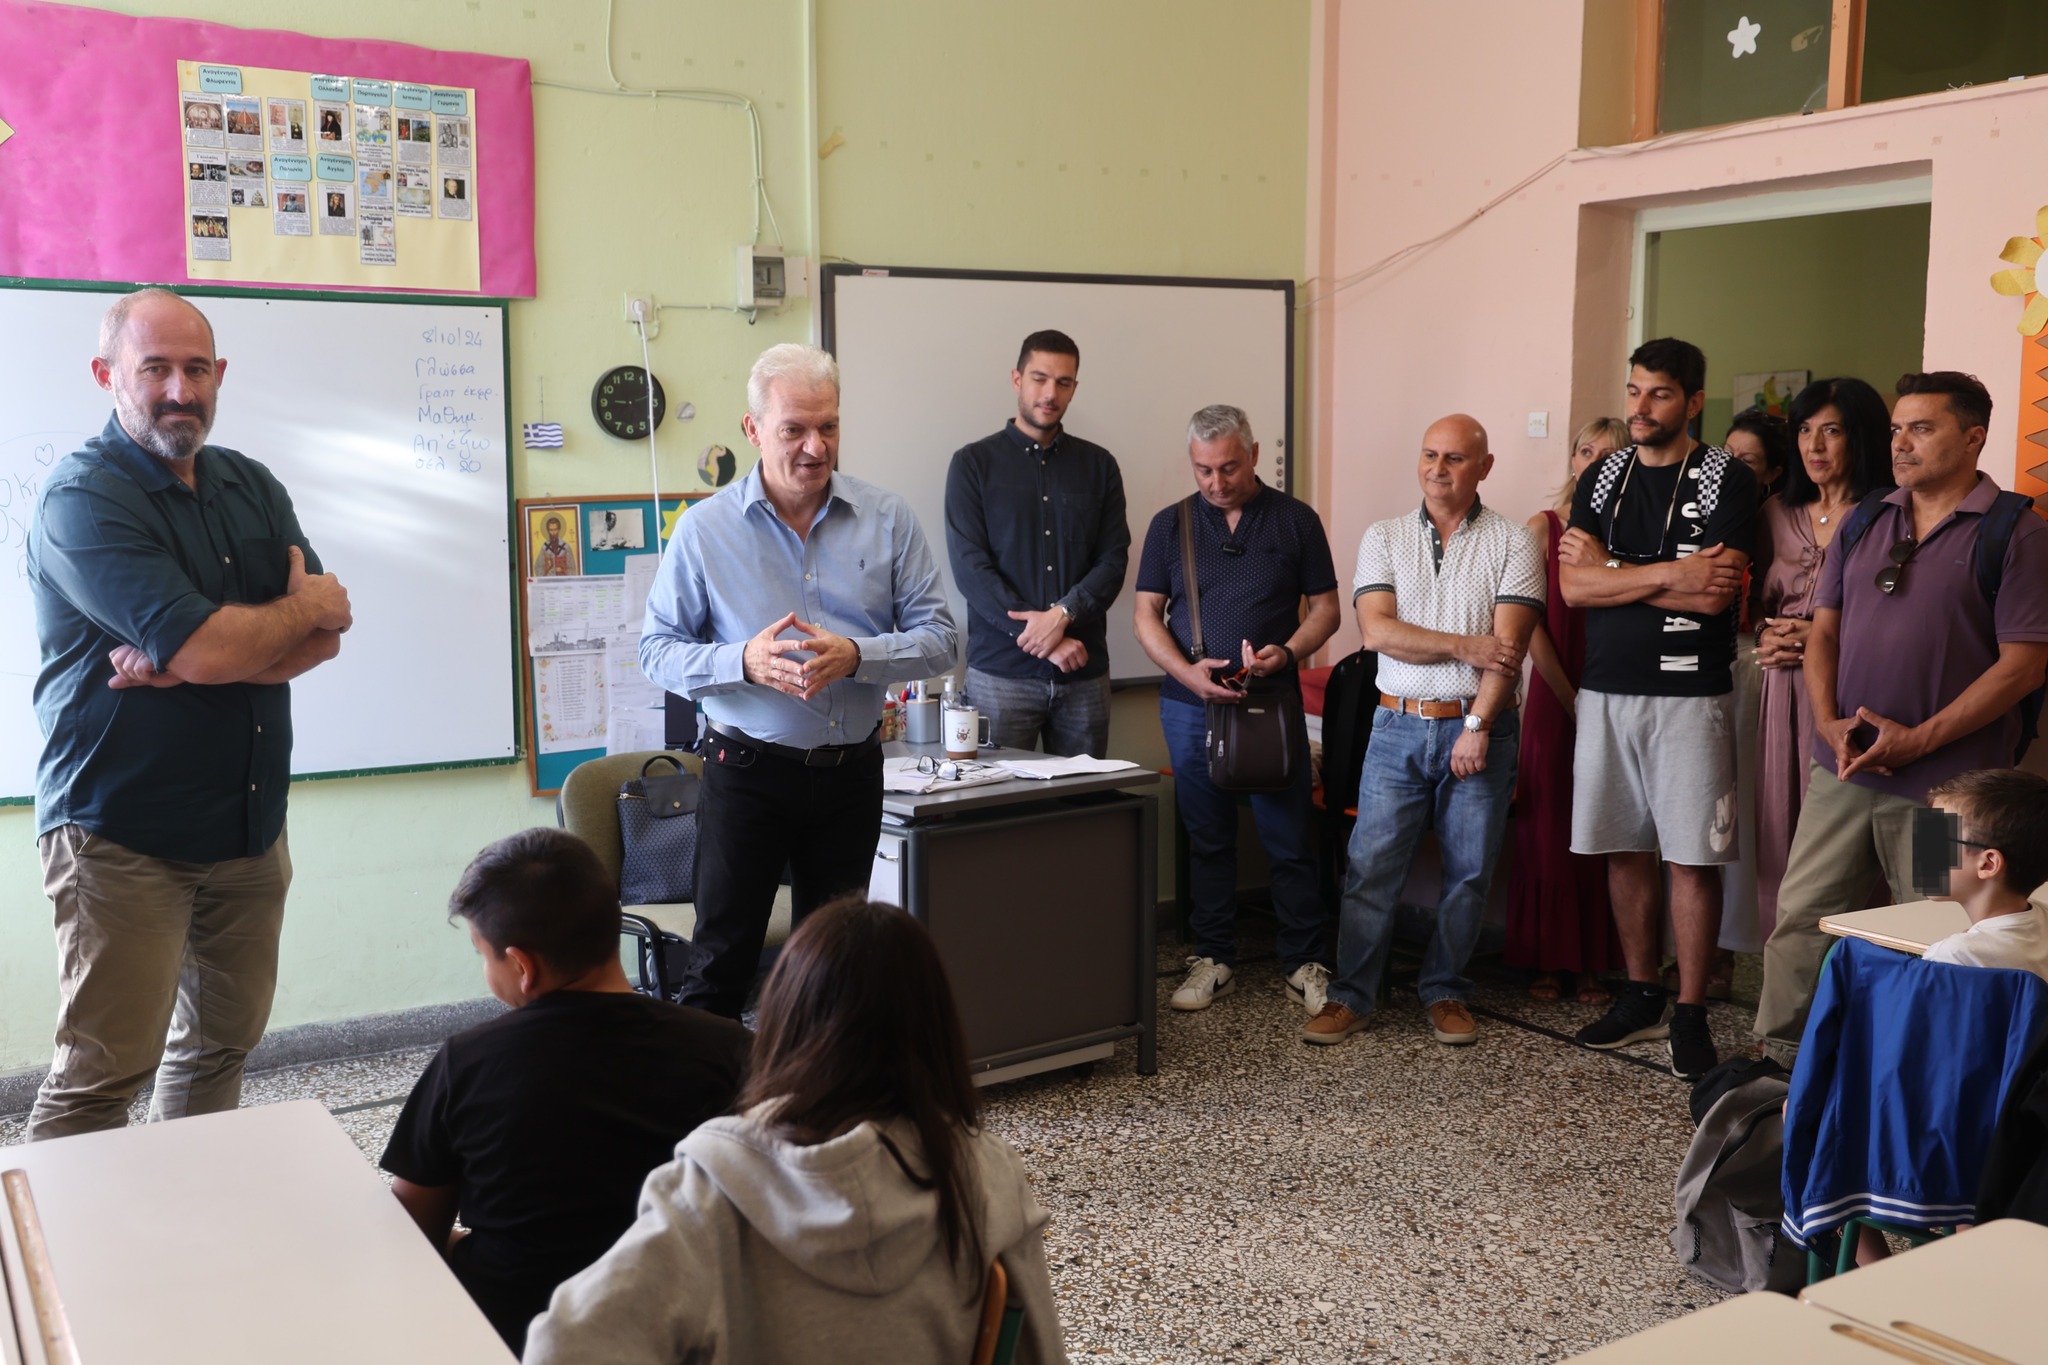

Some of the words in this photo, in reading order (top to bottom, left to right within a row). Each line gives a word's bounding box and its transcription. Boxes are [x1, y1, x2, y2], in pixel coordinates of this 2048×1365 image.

[612, 375, 620, 384] 11
[624, 371, 634, 381] 12
[639, 375, 644, 384] 1
[603, 385, 614, 394] 10
[600, 398, 608, 407] 9
[604, 411, 612, 420] 8
[615, 421, 622, 431] 7
[626, 424, 634, 434] 6
[639, 421, 646, 430] 5
